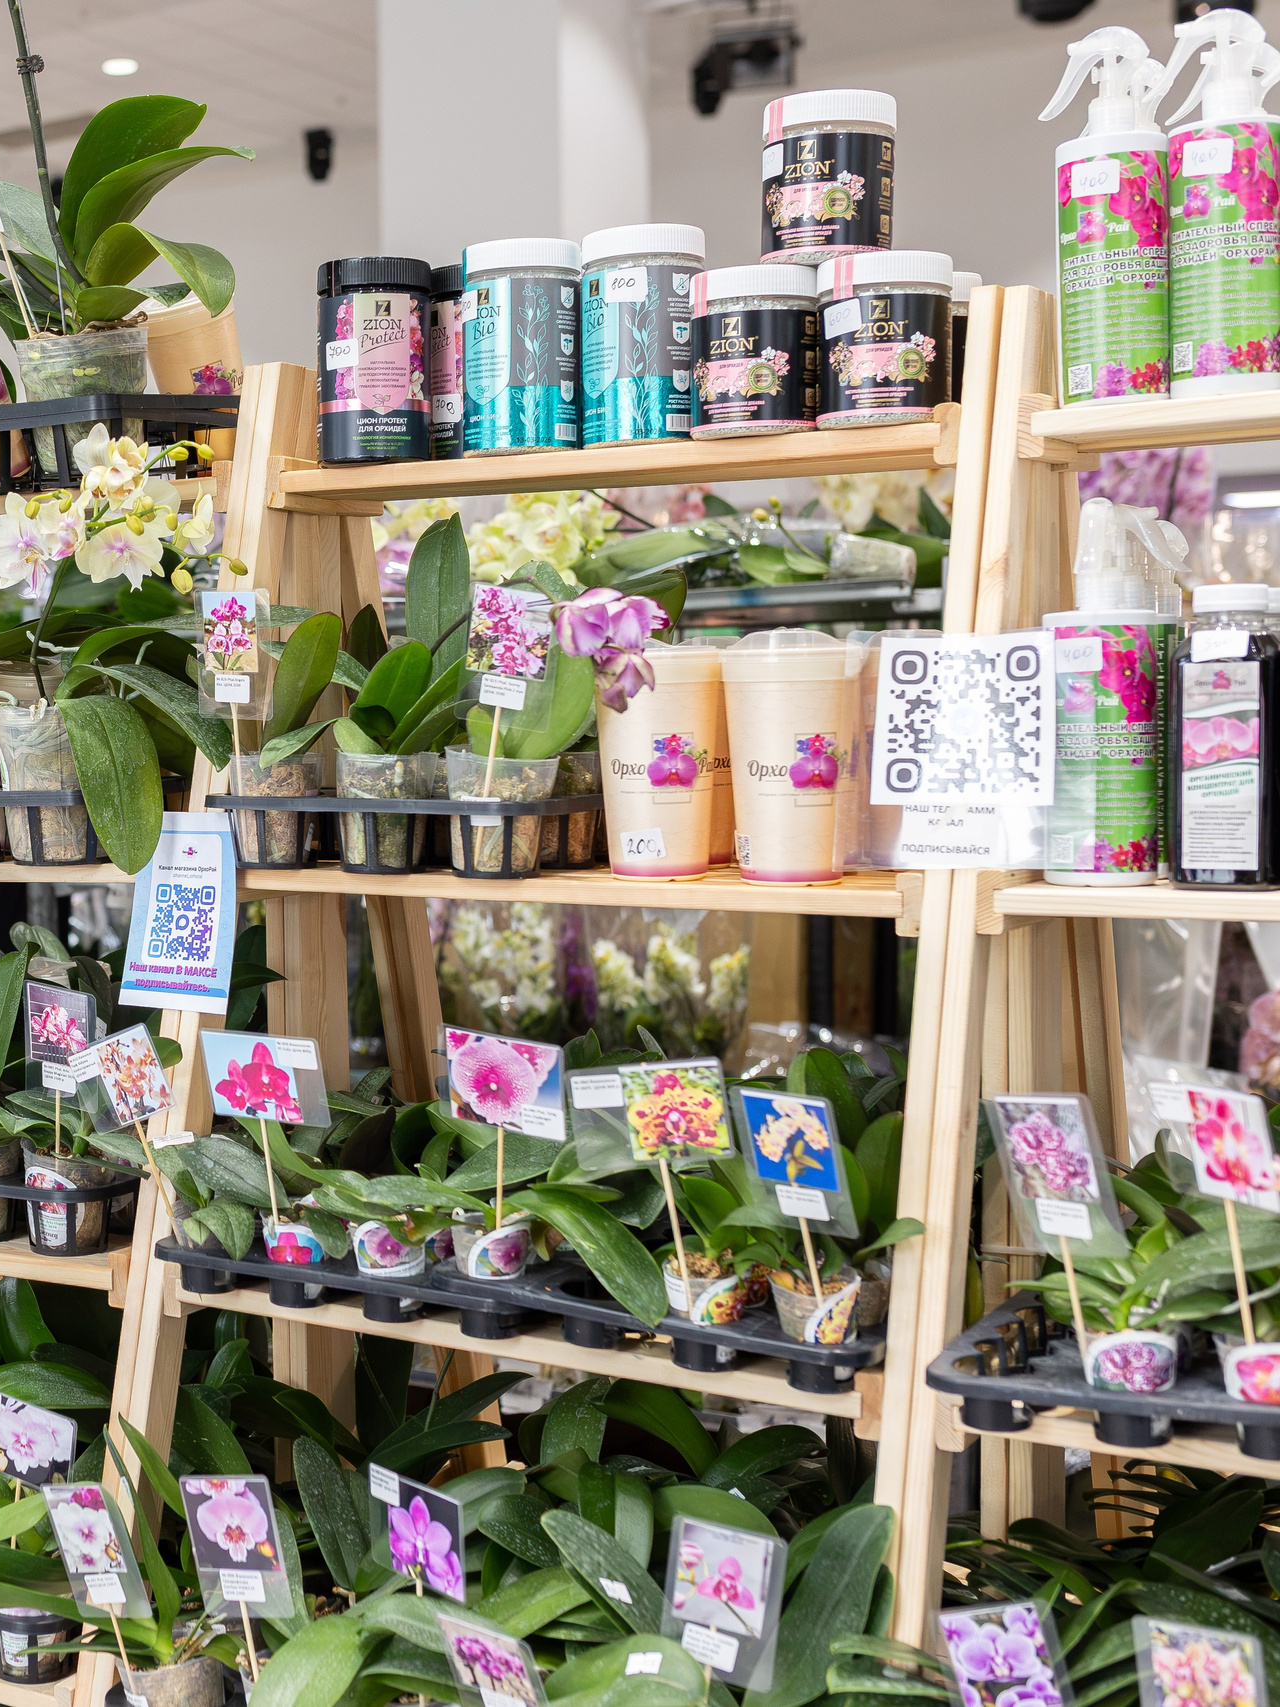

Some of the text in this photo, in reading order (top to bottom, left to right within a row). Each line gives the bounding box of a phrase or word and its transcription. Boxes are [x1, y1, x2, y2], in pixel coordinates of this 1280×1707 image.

[1191, 147, 1218, 166] 400
[785, 161, 830, 179] ZION
[1080, 172, 1108, 188] 400
[1108, 220, 1130, 234] Рай
[1186, 236, 1247, 251] ЗДОРОВЬЯ
[1064, 248, 1140, 269] ПИТАТЕЛЬНЫЙ
[1172, 252, 1217, 268] ОРХИДЕЙ
[1081, 260, 1142, 277] ЗДОРОВЬЯ
[611, 277, 636, 290] 800
[1066, 275, 1114, 293] ОРХИДЕЙ
[363, 319, 402, 331] ZION
[587, 313, 604, 333] Bio
[829, 308, 850, 327] 600
[358, 327, 408, 348] Protect
[432, 327, 447, 340] ON
[473, 321, 496, 340] Bio
[854, 321, 905, 338] ZION
[328, 345, 351, 359] 700
[710, 338, 754, 354] ZION
[358, 425, 406, 433] ДЛЯ ОРХИДЕЙ
[378, 417, 408, 425] ПРОТЕКТ
[1062, 646, 1094, 662] 400
[1066, 736, 1129, 746] ЗДОРОВЬЯ
[1057, 748, 1101, 759] РХИДЕЙ
[611, 758, 646, 780] Орхо
[747, 760, 788, 781] Орхо
[905, 804, 995, 815] НАШ ТЕЛАММ
[902, 844, 990, 855] ПОДПИСЫВАЙСЯ
[129, 961, 218, 978] Наш канал В МАКСЕ
[134, 976, 210, 993] подписывайтесь.
